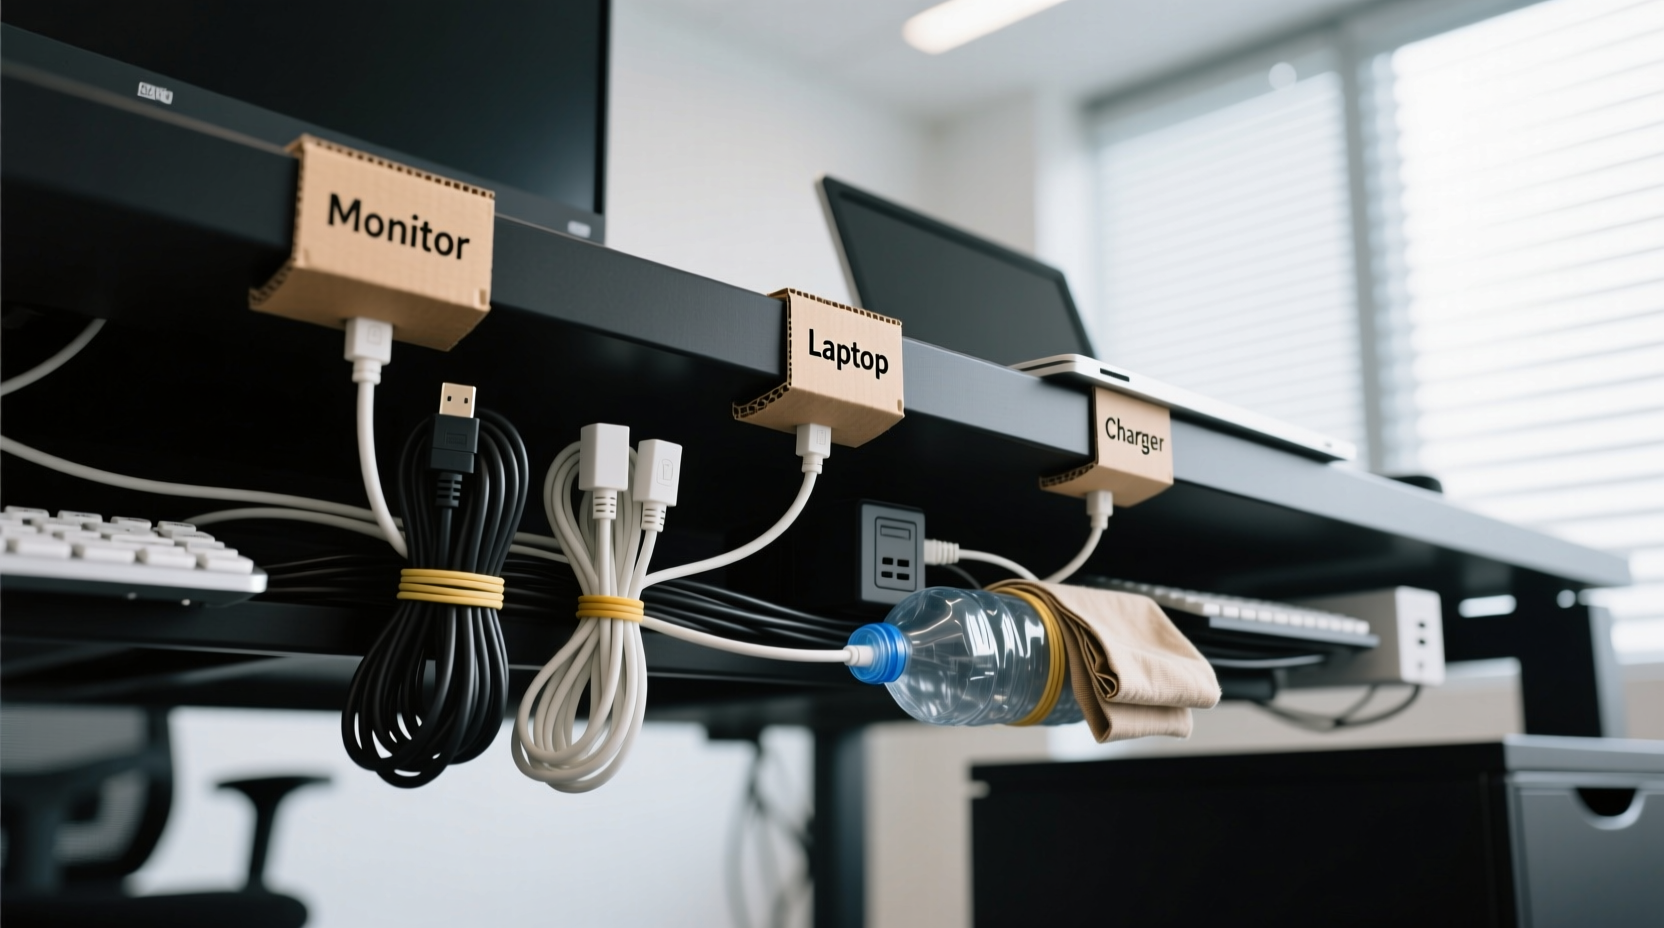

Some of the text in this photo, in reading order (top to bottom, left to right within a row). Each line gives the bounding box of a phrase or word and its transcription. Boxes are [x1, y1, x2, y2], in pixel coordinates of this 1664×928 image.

[327, 193, 470, 260] Monitor
[808, 328, 889, 380] Laptop
[1105, 417, 1164, 455] Charger
